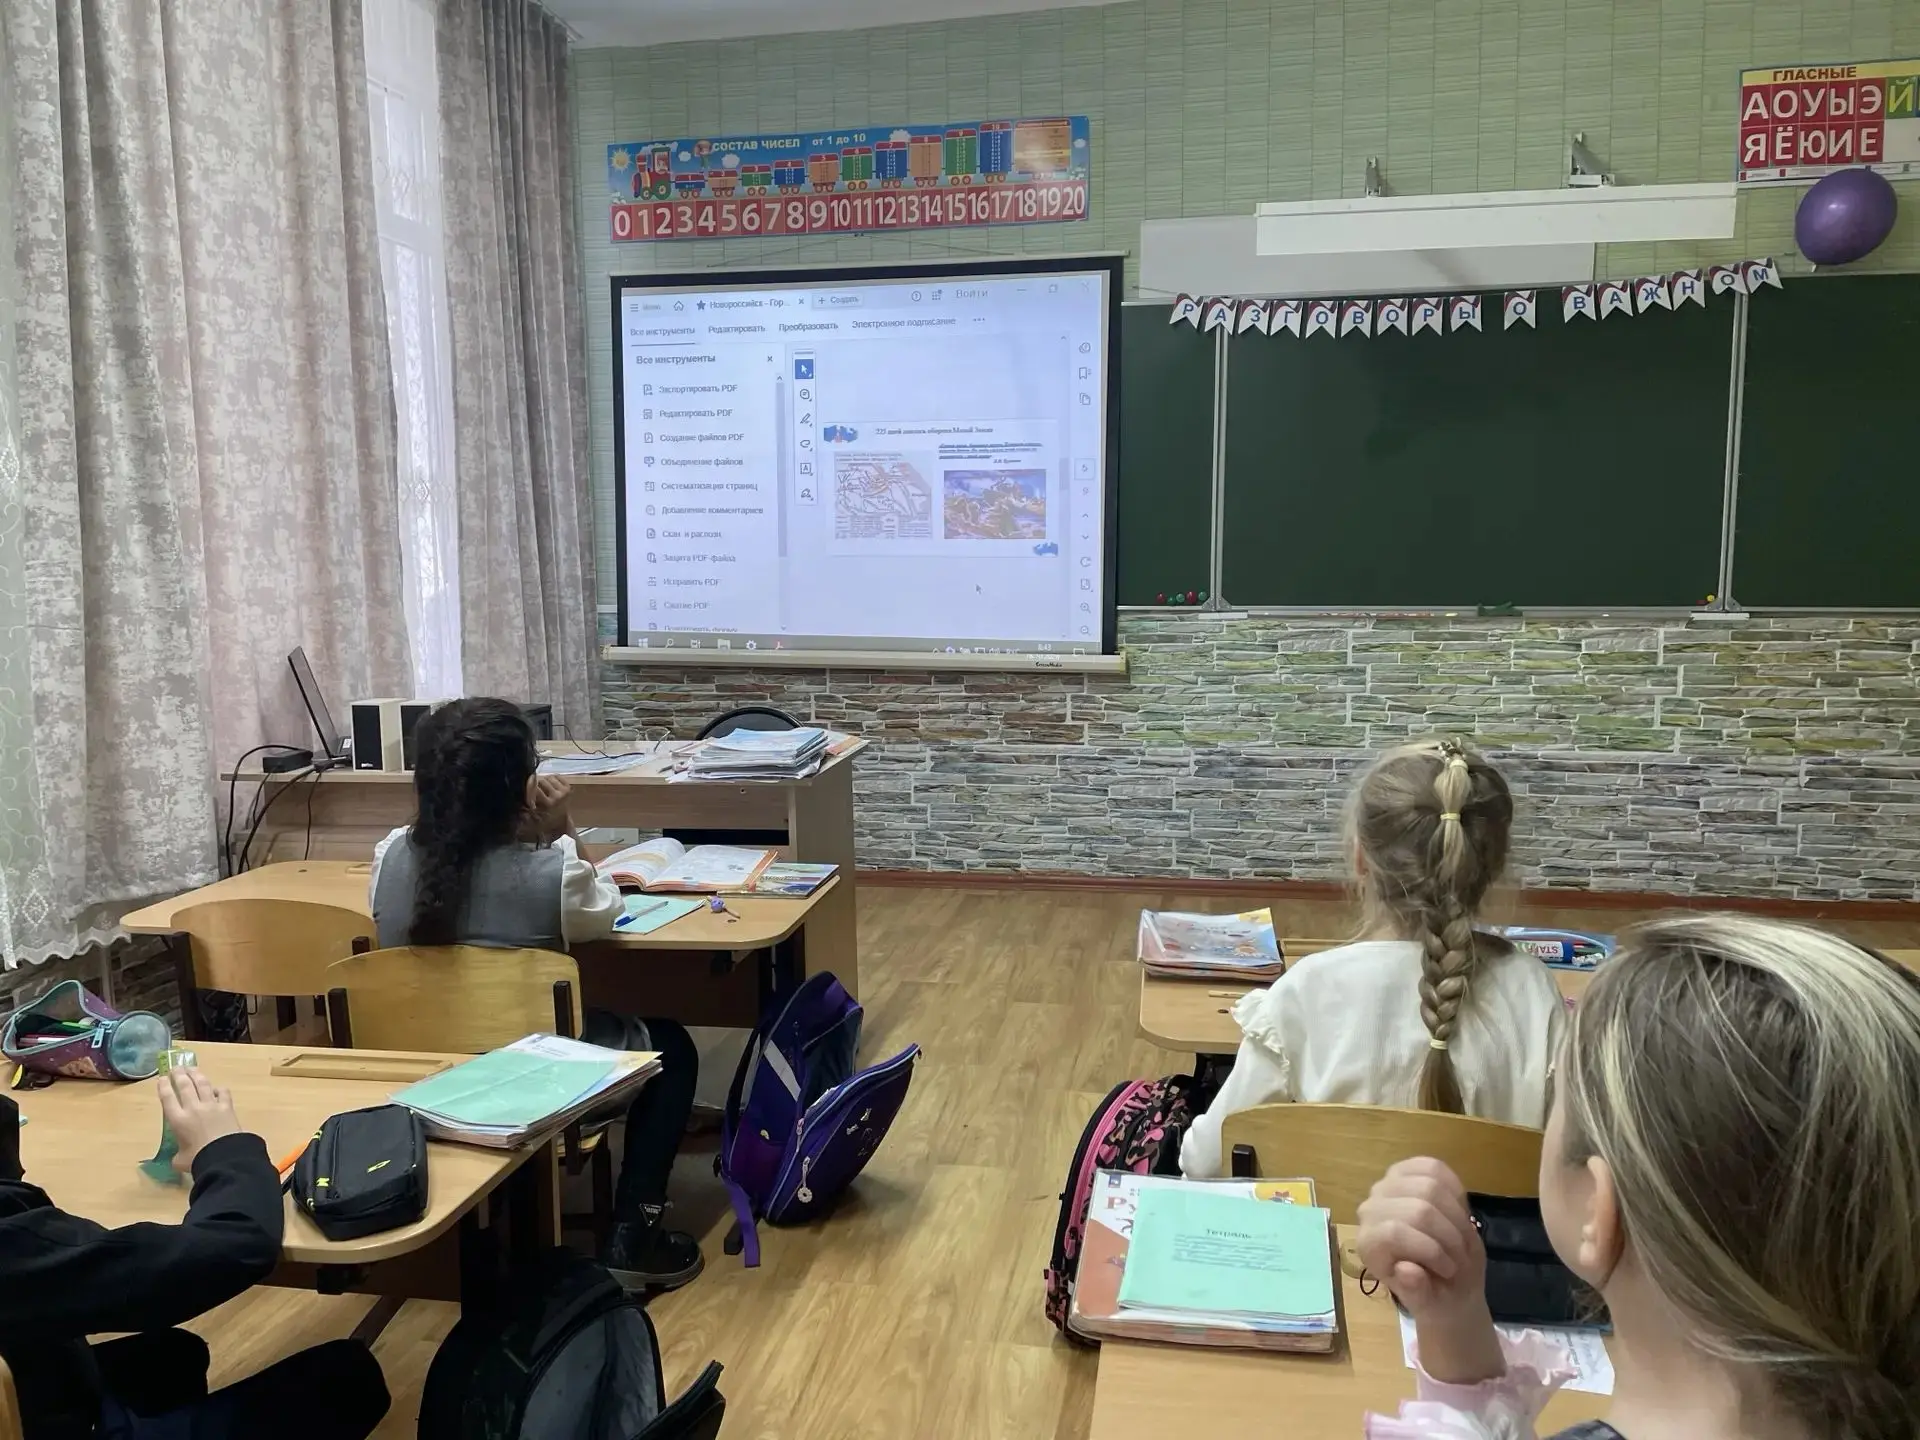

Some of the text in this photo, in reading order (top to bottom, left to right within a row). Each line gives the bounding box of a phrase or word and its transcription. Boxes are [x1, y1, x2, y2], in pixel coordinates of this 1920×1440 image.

[1773, 66, 1857, 82] ГЛАСНЫЕ
[713, 134, 866, 151] СОСТАВ ЧИСЕЛ от 1 до 10
[614, 186, 1085, 236] 0 1 2 3 4 5 6 7 8 9 10 11 12 13 14 15 16 17 18 19 20
[956, 289, 988, 298] Войти
[1182, 268, 1769, 325] РАЗГОВОРЫ О ВАЖНОМ
[710, 300, 763, 310] Новороссийск
[779, 322, 838, 332] Преобразовать
[852, 319, 906, 329] Электронное
[646, 328, 696, 336] инструменты
[708, 326, 766, 334] Редактировать
[636, 354, 716, 365] Все инструменты
[722, 384, 738, 392] PDF
